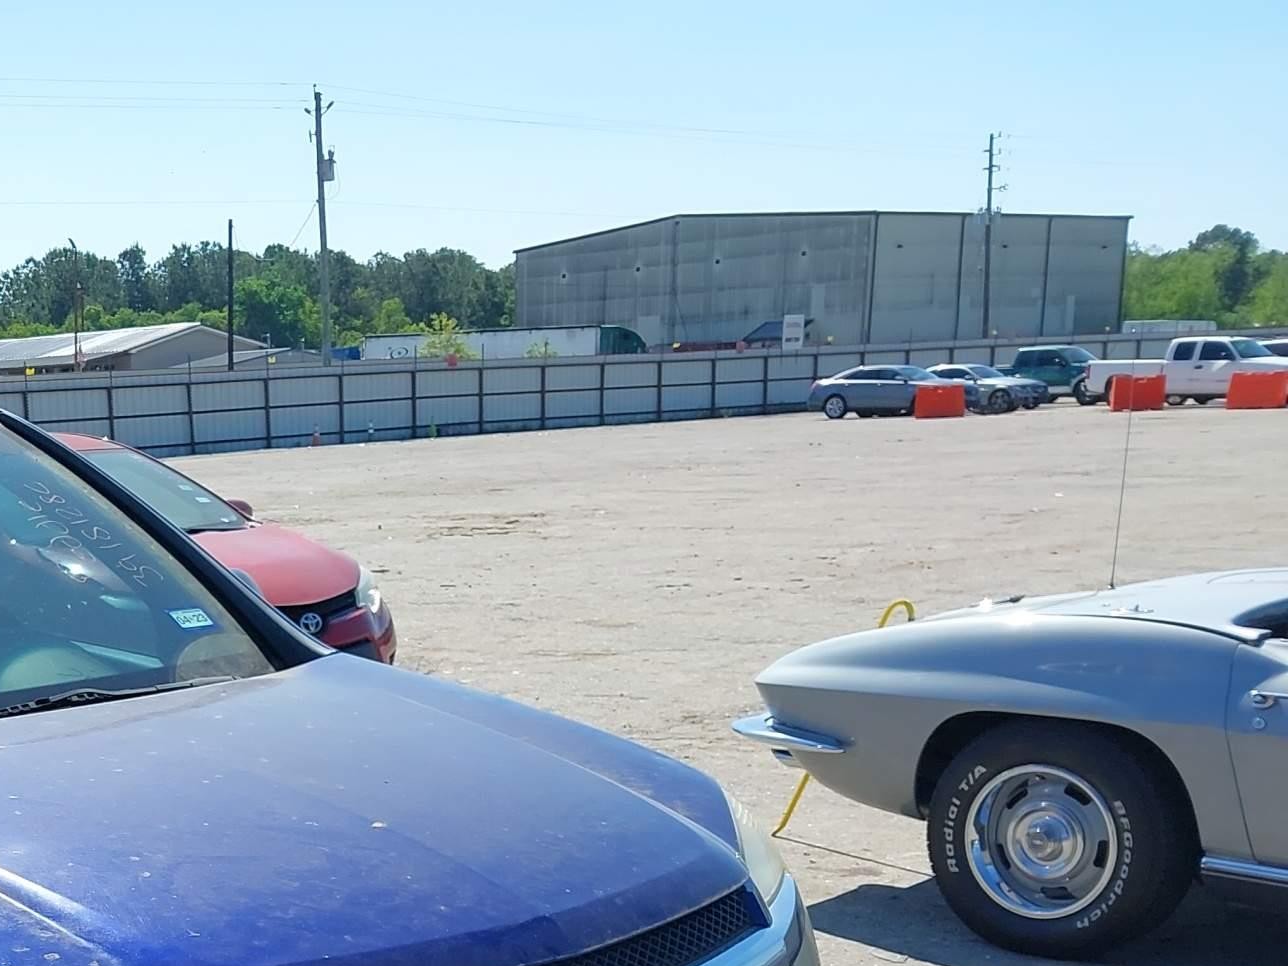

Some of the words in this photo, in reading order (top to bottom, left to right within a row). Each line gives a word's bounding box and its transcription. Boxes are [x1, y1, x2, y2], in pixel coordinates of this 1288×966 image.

[942, 797, 961, 873] Radial
[958, 764, 987, 792] T/A
[1076, 800, 1134, 929] BFGoodrich
